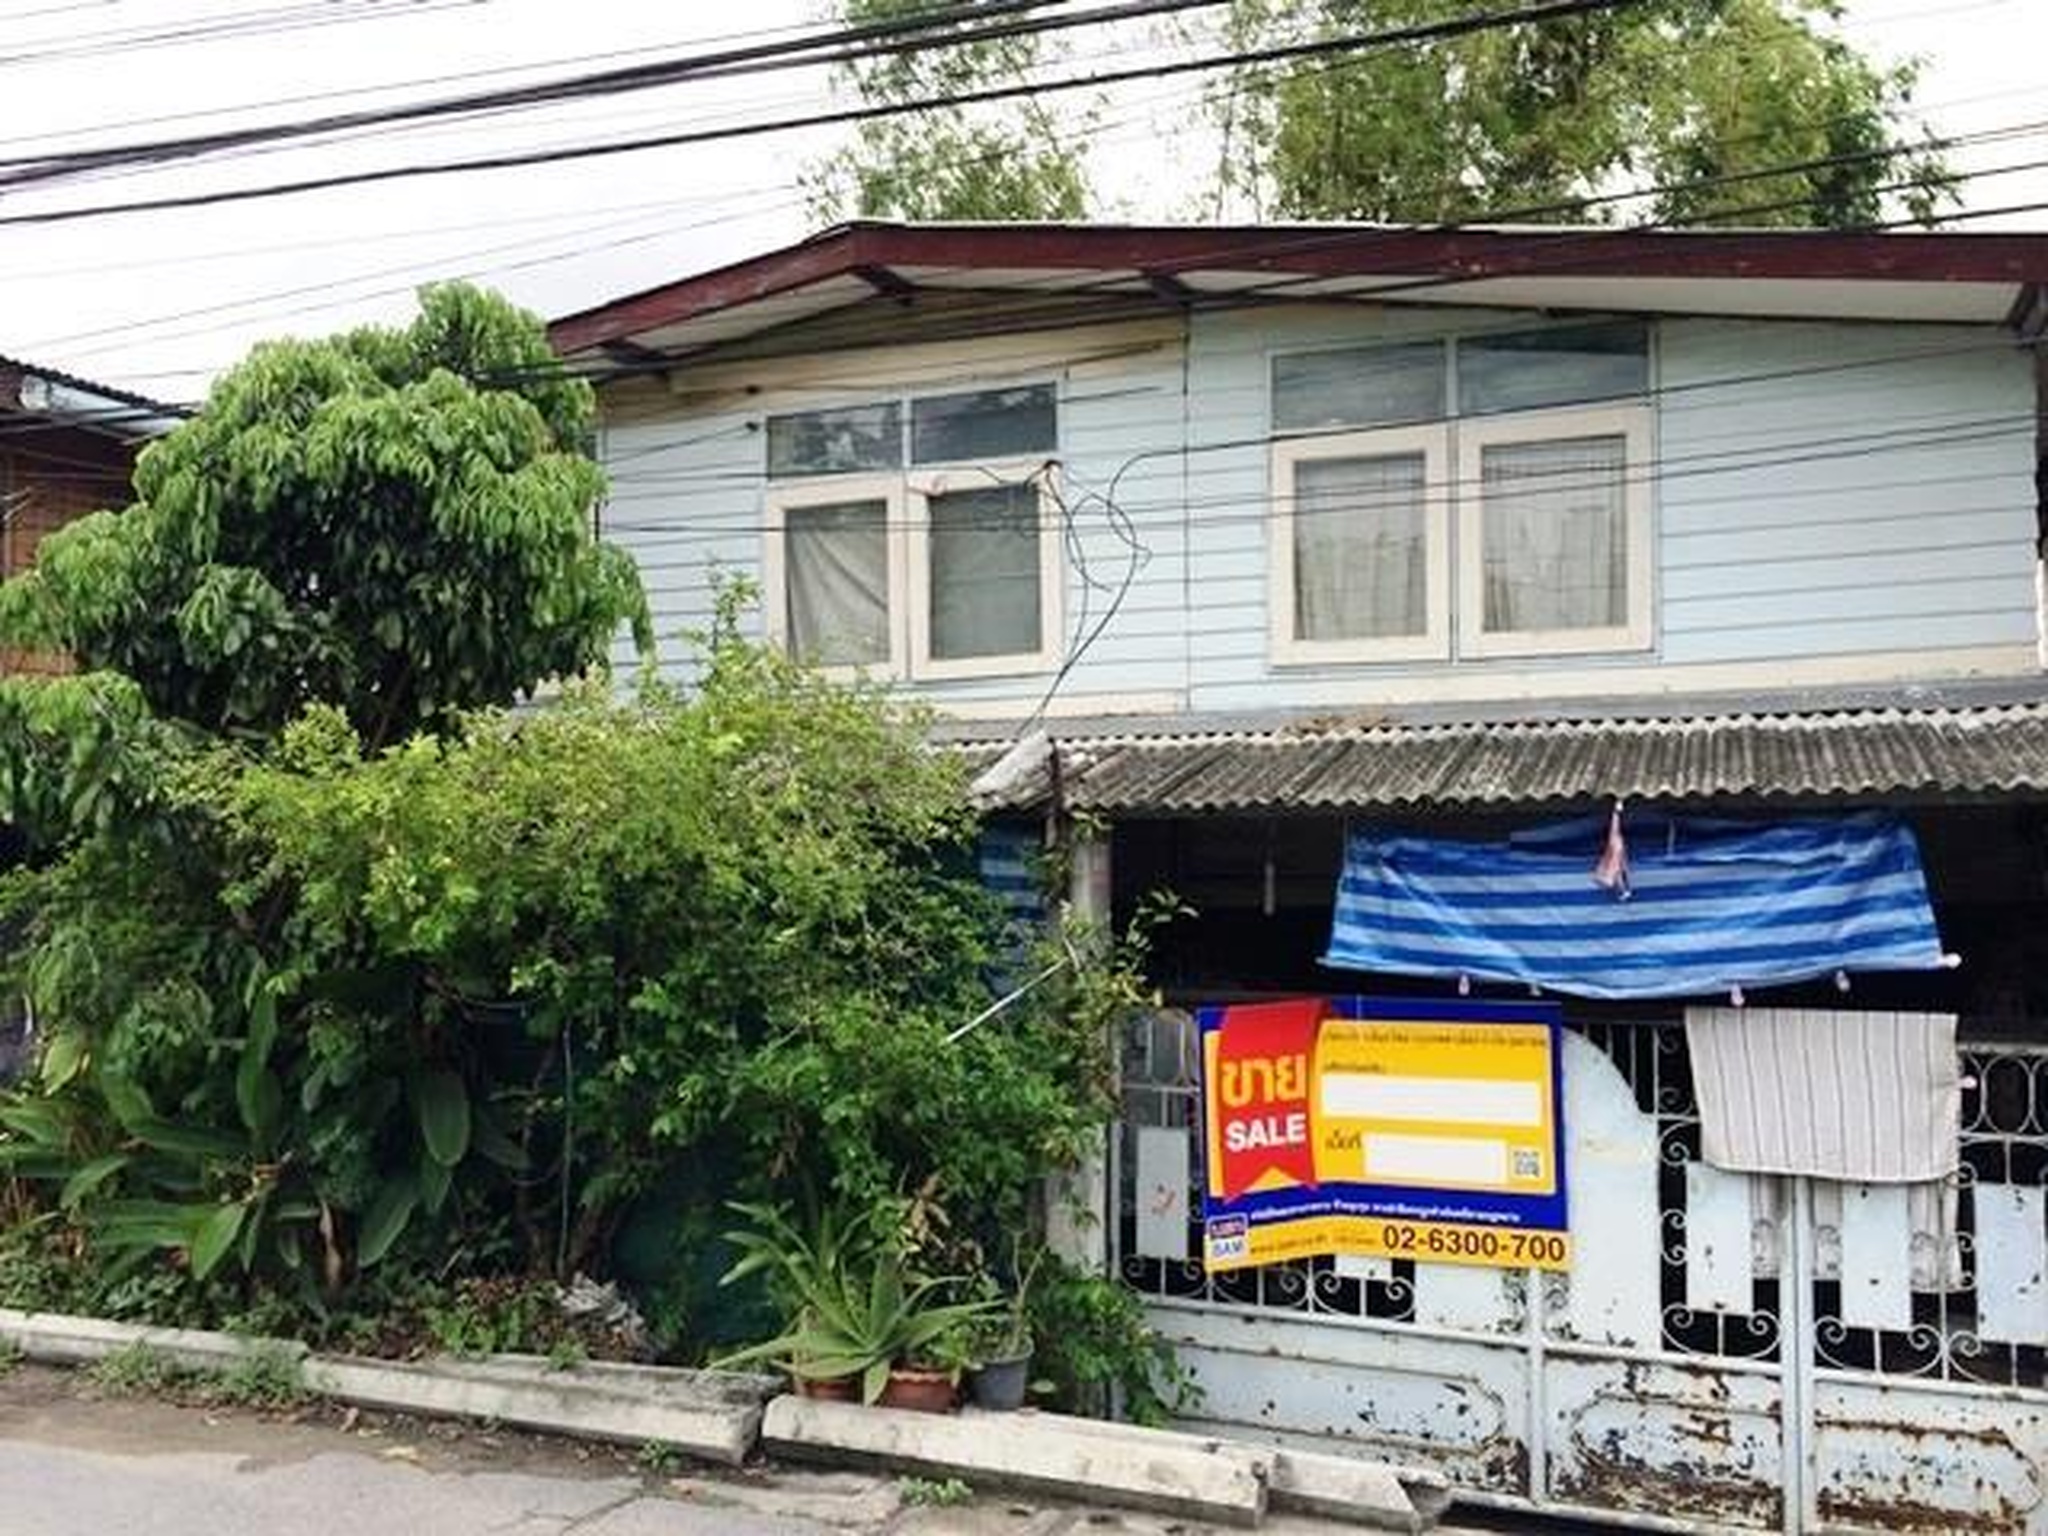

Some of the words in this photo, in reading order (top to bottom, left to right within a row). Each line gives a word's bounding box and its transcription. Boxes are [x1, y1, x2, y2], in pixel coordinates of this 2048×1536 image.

[1221, 1055, 1306, 1108] ขาย
[1226, 1113, 1306, 1152] SALE
[1383, 1225, 1566, 1261] 02-6300-700
